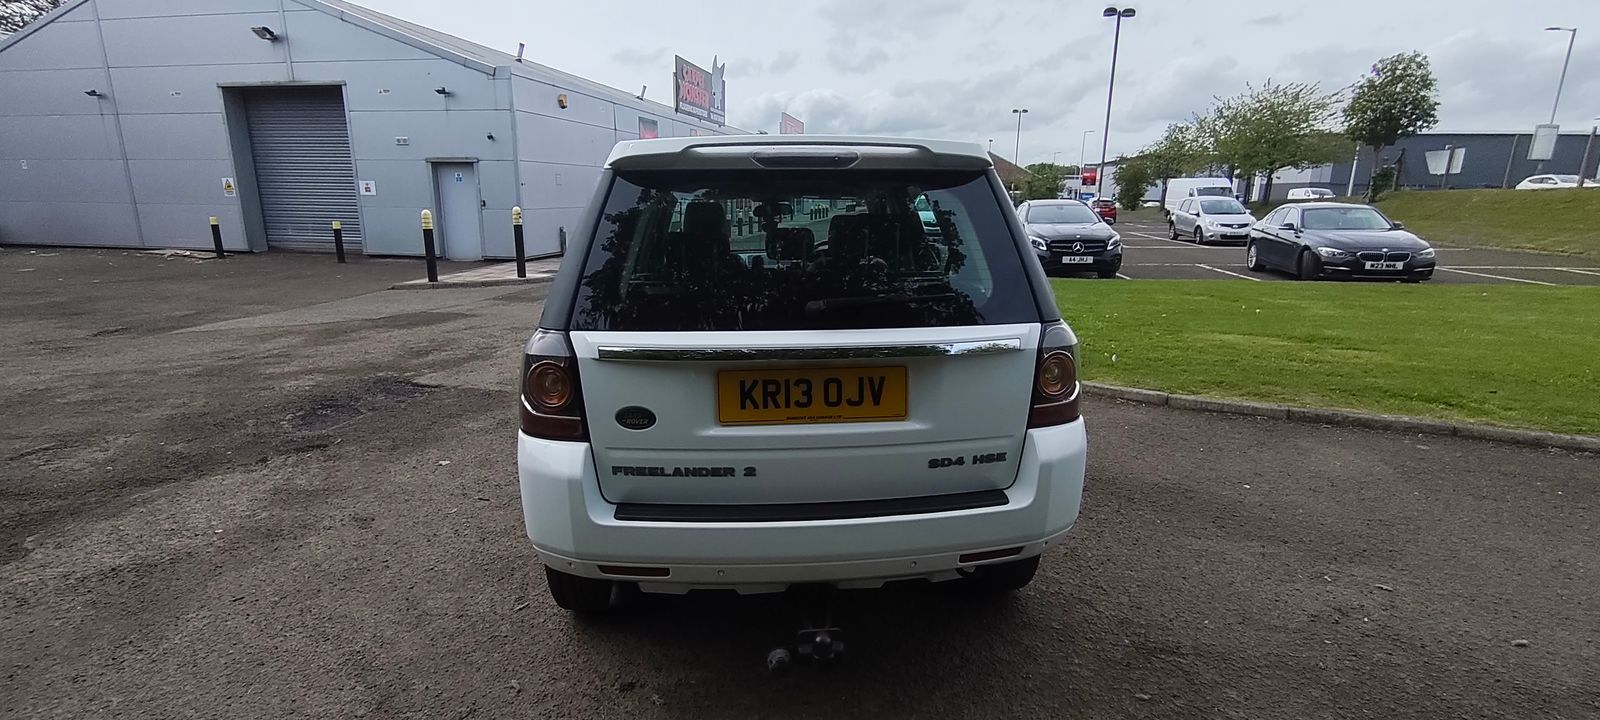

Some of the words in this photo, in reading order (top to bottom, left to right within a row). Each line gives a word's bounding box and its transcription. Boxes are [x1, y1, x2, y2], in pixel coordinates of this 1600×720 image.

[678, 80, 709, 110] MONSTER
[739, 378, 813, 410] KR13
[823, 376, 886, 408] OJV
[611, 466, 736, 477] FREELANDER
[743, 466, 757, 477] 2
[927, 456, 965, 468] SD4
[972, 452, 1007, 465] HSE
